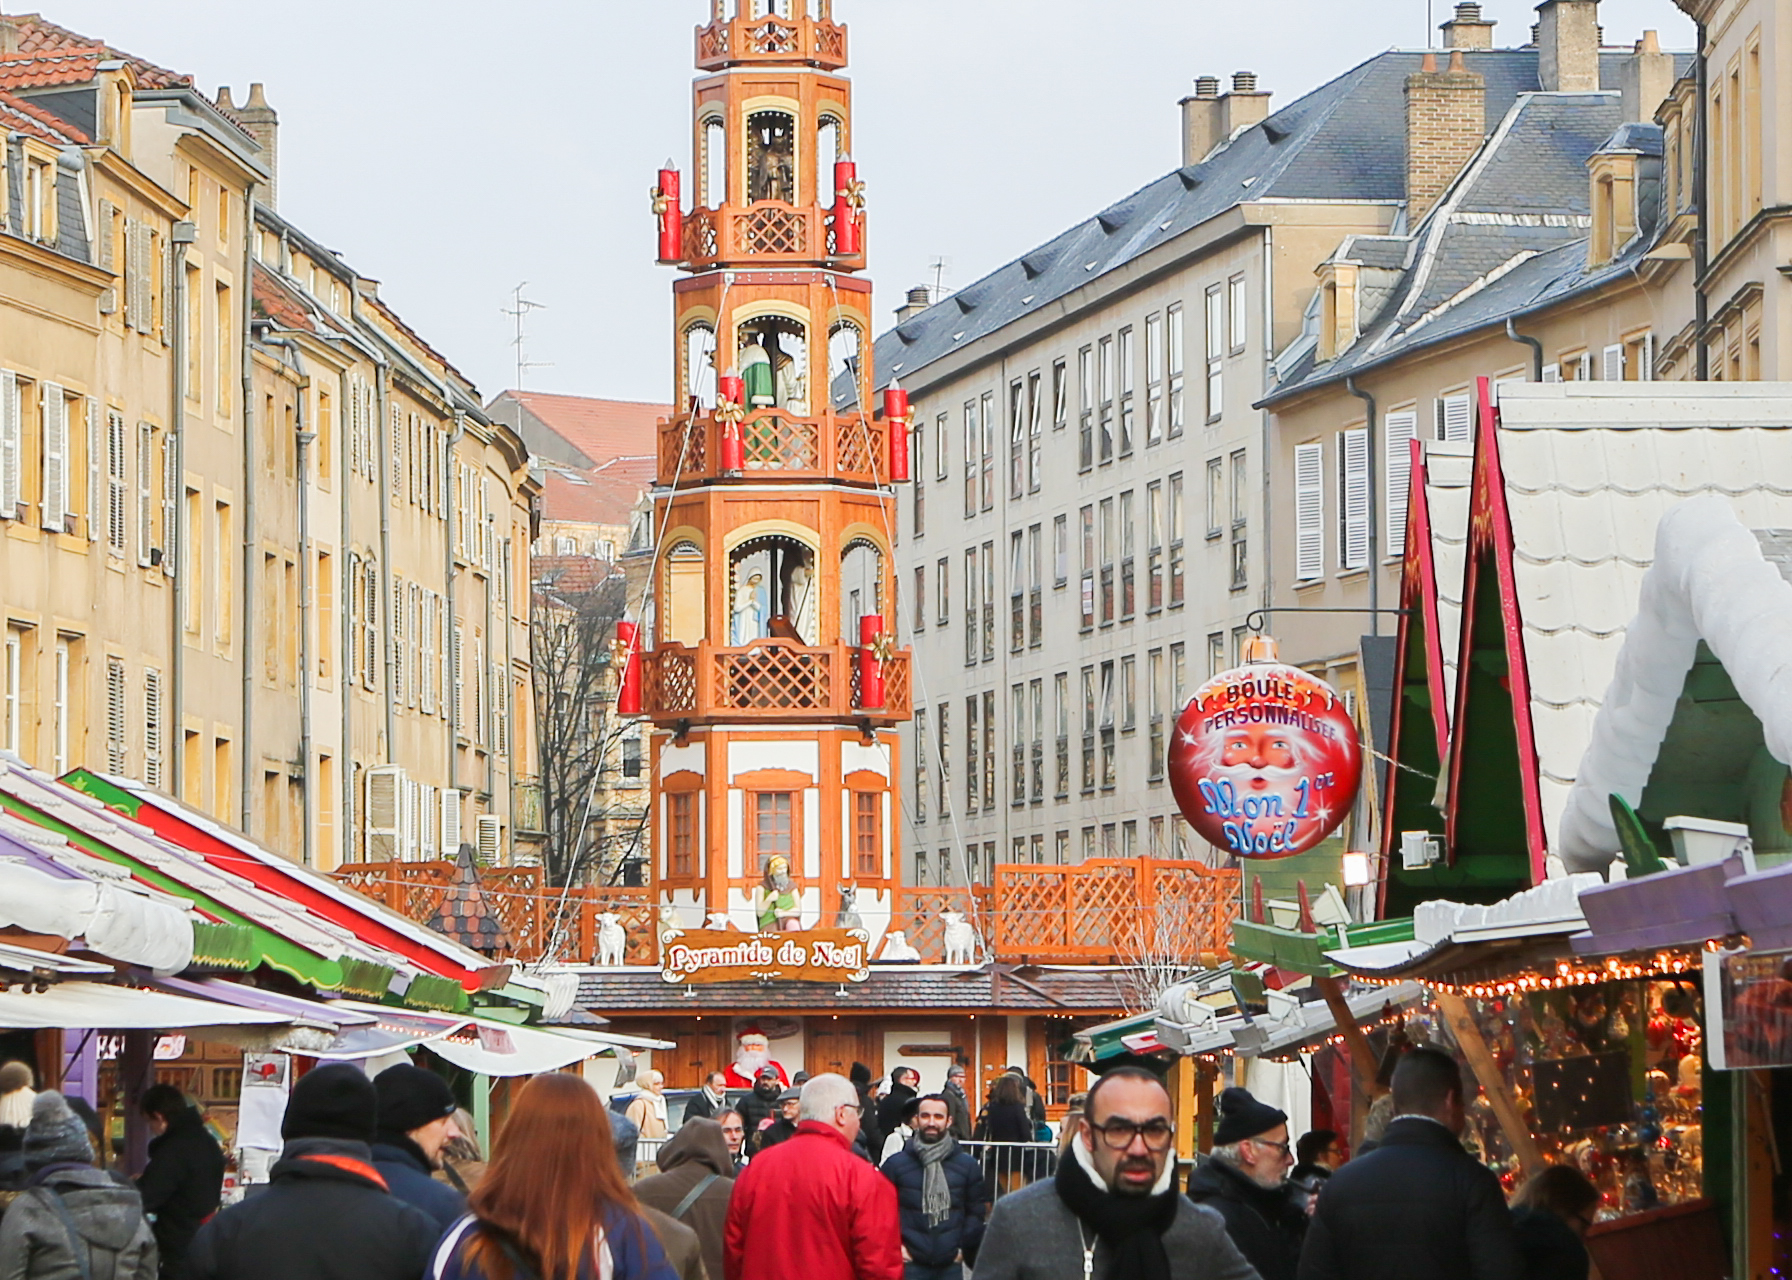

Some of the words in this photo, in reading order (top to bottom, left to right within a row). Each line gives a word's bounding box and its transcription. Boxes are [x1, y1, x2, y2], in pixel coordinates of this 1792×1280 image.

[1226, 678, 1295, 704] BOULE
[1198, 776, 1285, 820] Mon
[1222, 818, 1299, 855] Noël
[670, 941, 773, 972] Pyramide
[778, 939, 806, 967] de
[811, 940, 863, 969] Noël
